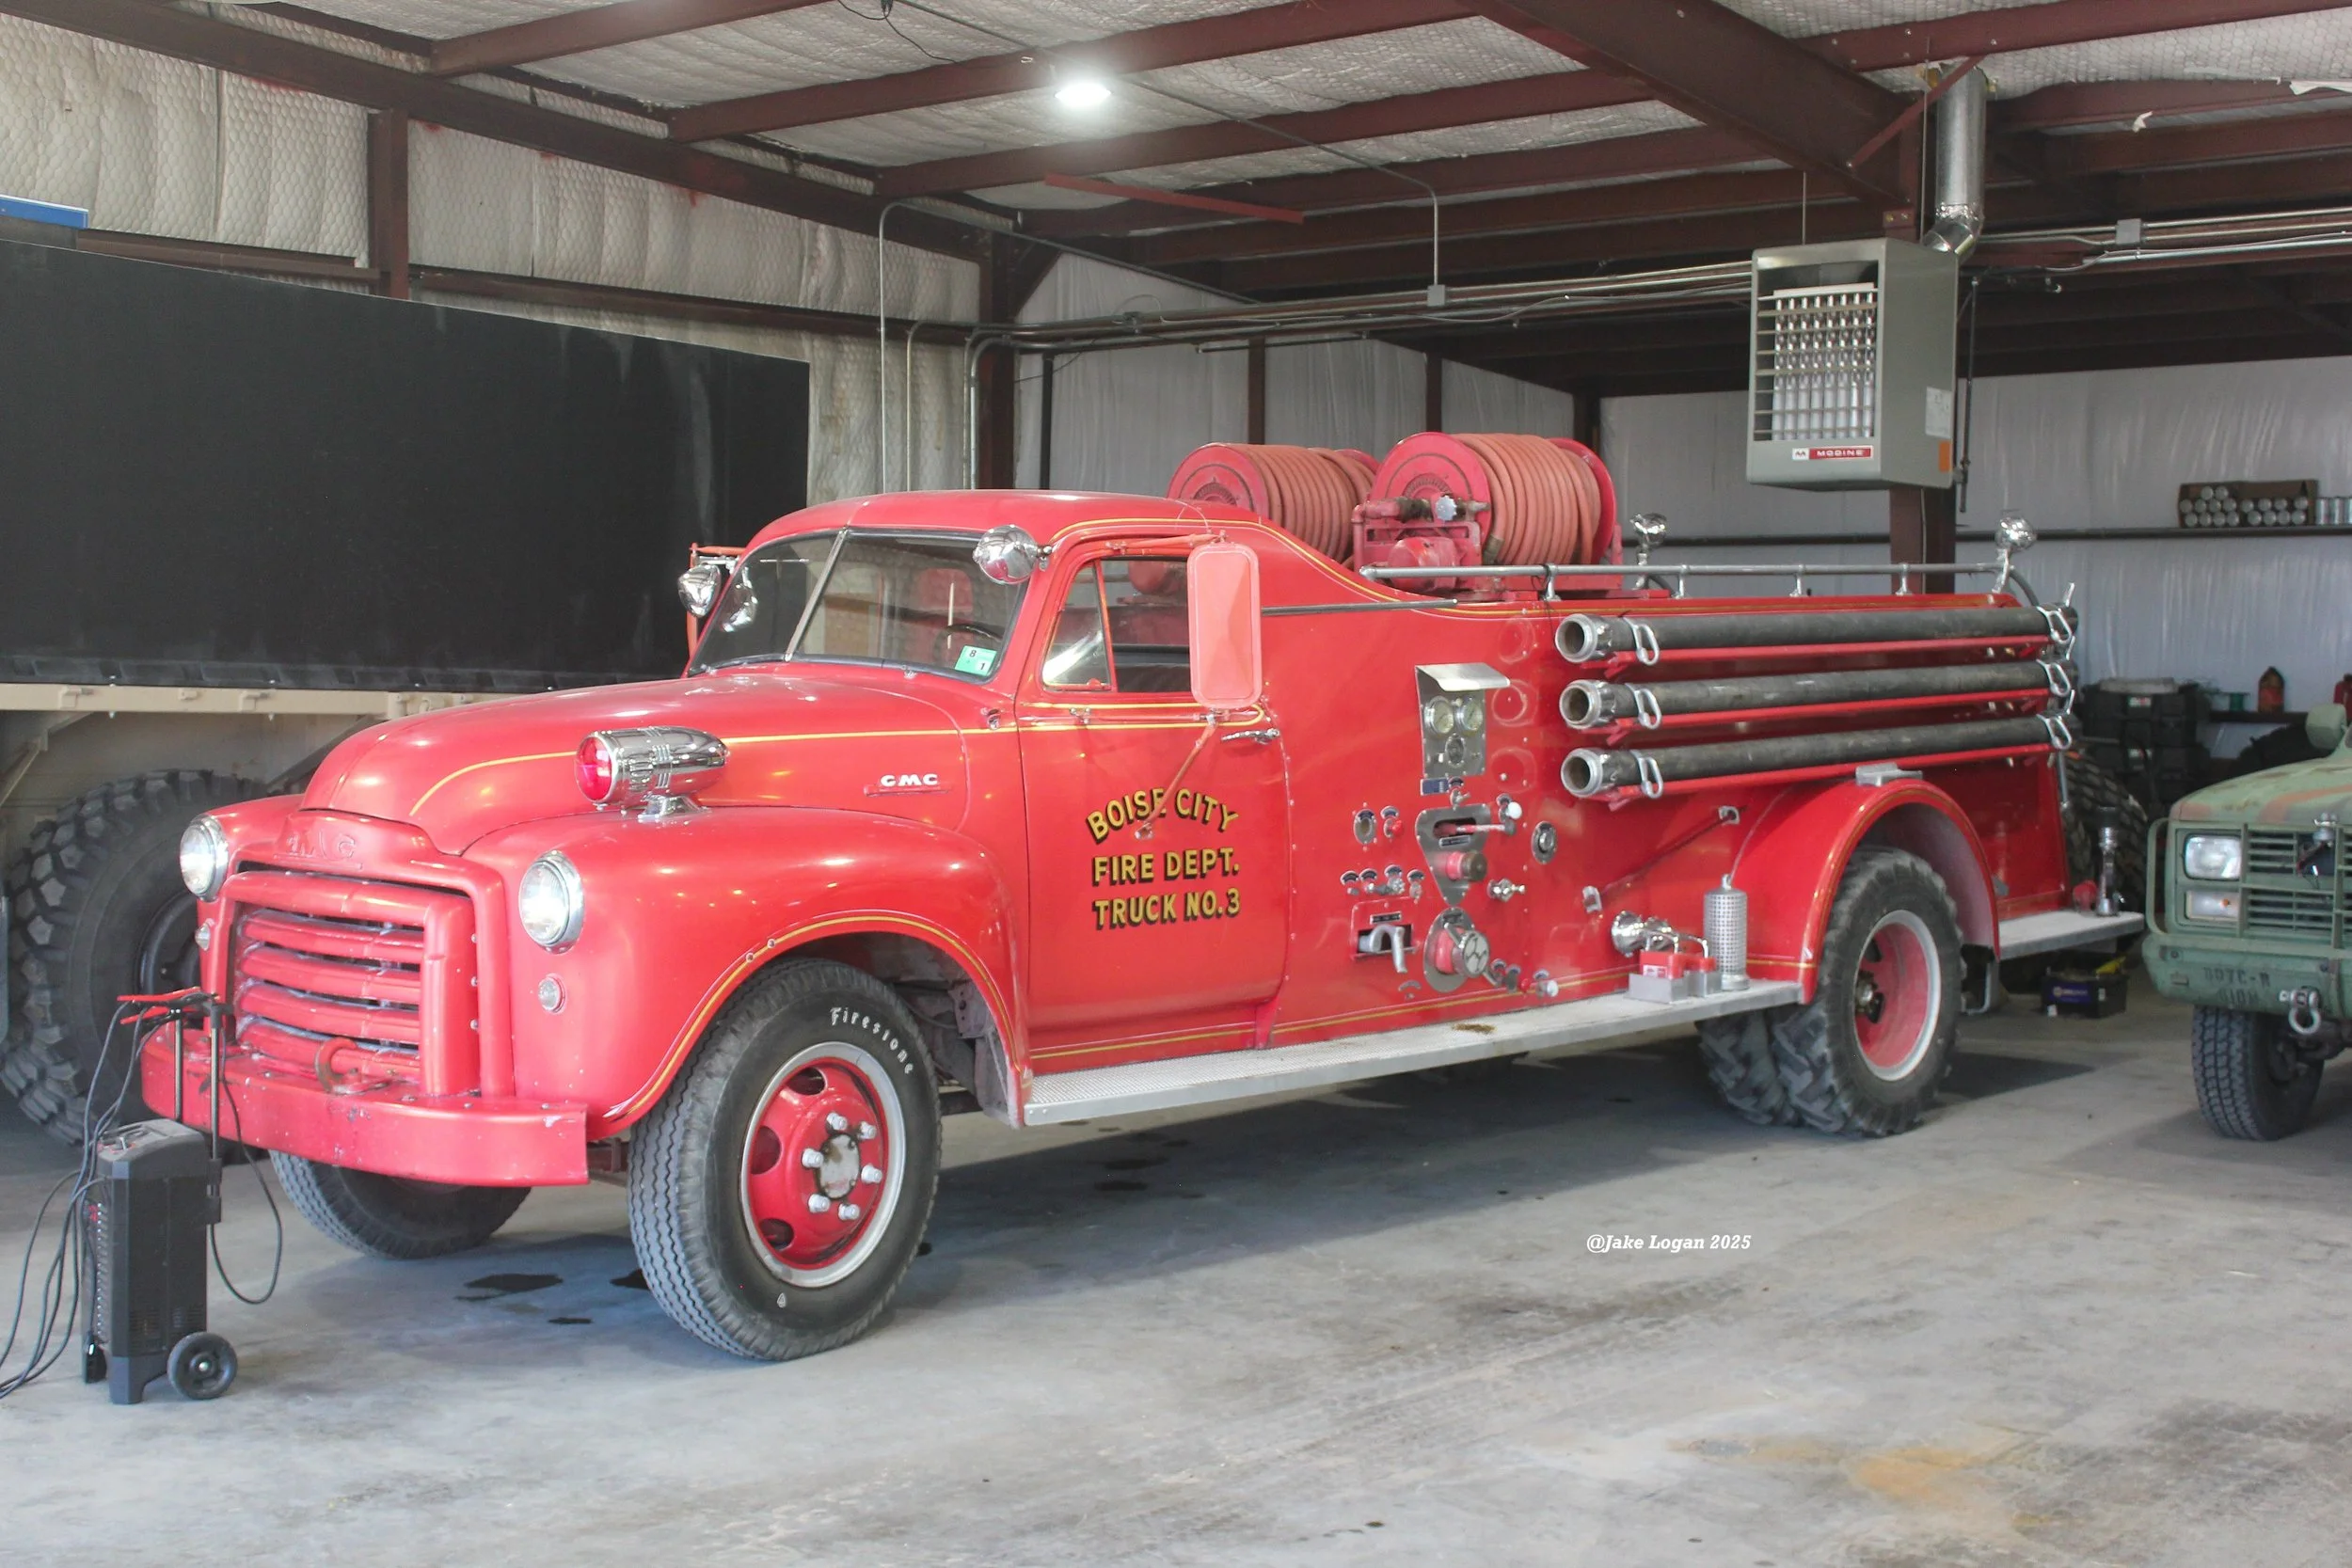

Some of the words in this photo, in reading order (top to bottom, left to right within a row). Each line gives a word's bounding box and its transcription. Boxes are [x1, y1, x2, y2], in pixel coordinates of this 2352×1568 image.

[969, 649, 977, 658] 8
[979, 662, 986, 671] 1
[880, 773, 939, 787] GMC
[1087, 788, 1167, 845] BOISE
[1175, 788, 1239, 832] CITY
[1092, 853, 1154, 886] FIRE
[1164, 847, 1240, 880] DEPT.
[1092, 893, 1177, 930] TRUCK
[830, 1006, 914, 1074] Firestone
